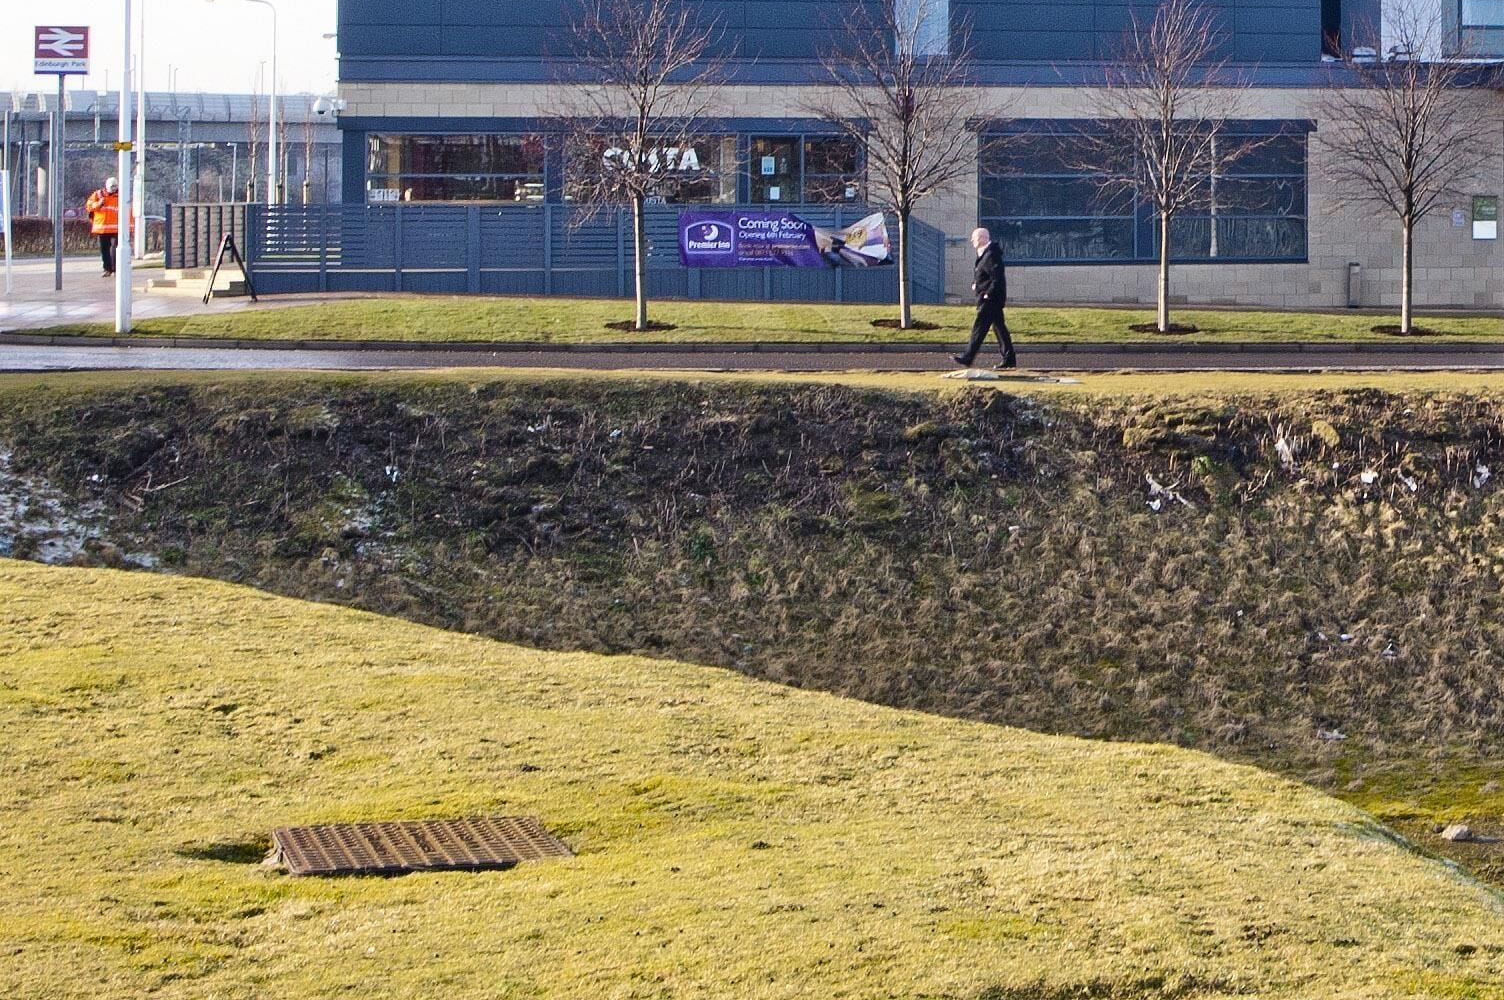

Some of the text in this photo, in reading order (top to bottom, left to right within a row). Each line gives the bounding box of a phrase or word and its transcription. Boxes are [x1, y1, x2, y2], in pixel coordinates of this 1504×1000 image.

[738, 217, 807, 232] Coming Soon
[738, 231, 766, 240] Opening
[778, 231, 807, 241] February
[688, 240, 717, 249] Premier
[717, 240, 731, 249] Inn
